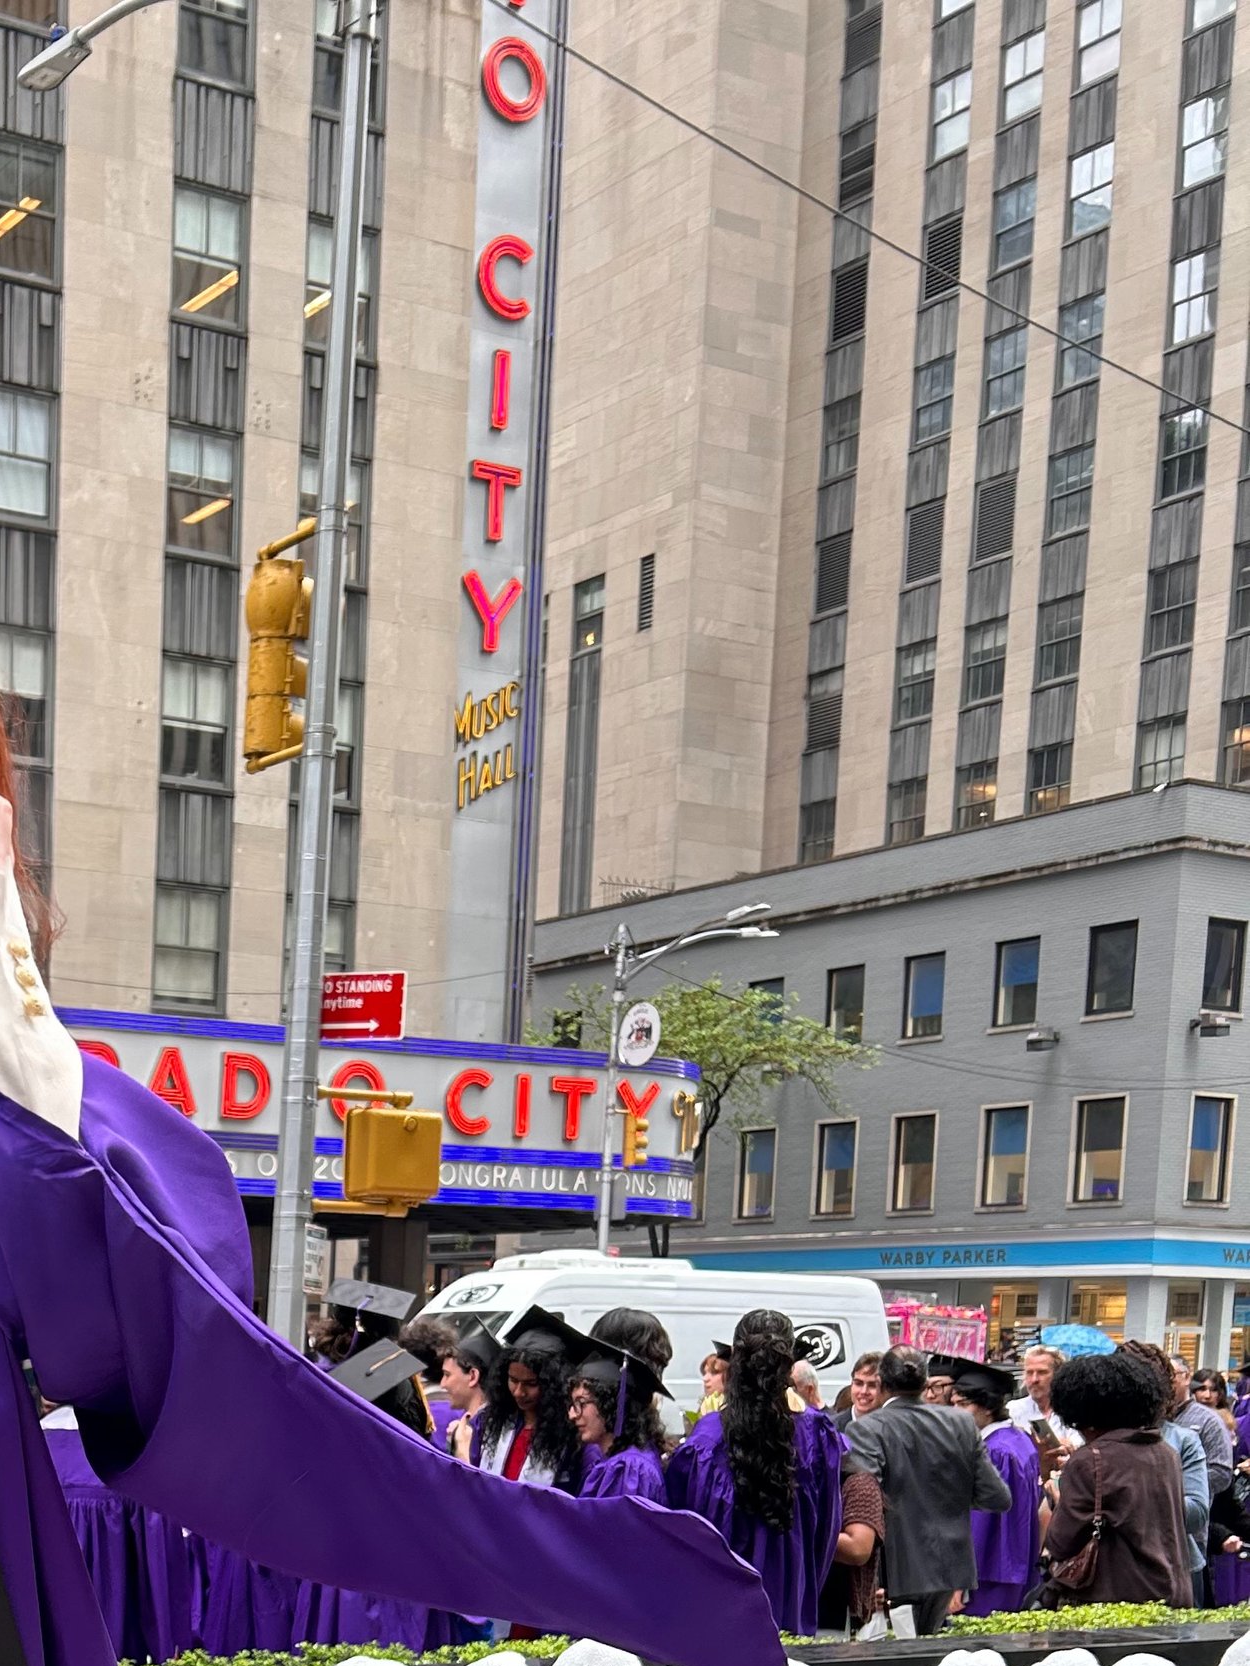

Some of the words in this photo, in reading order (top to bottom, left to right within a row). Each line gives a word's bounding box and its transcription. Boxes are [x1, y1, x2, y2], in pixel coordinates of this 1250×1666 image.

[463, 234, 535, 653] CITY
[324, 981, 334, 994] O
[335, 979, 393, 994] STANDING
[323, 997, 364, 1012] nytime
[78, 1040, 387, 1123] ADO
[446, 1068, 661, 1140] CITY
[880, 1251, 935, 1265] WARBY
[942, 1248, 1007, 1264] PARKER
